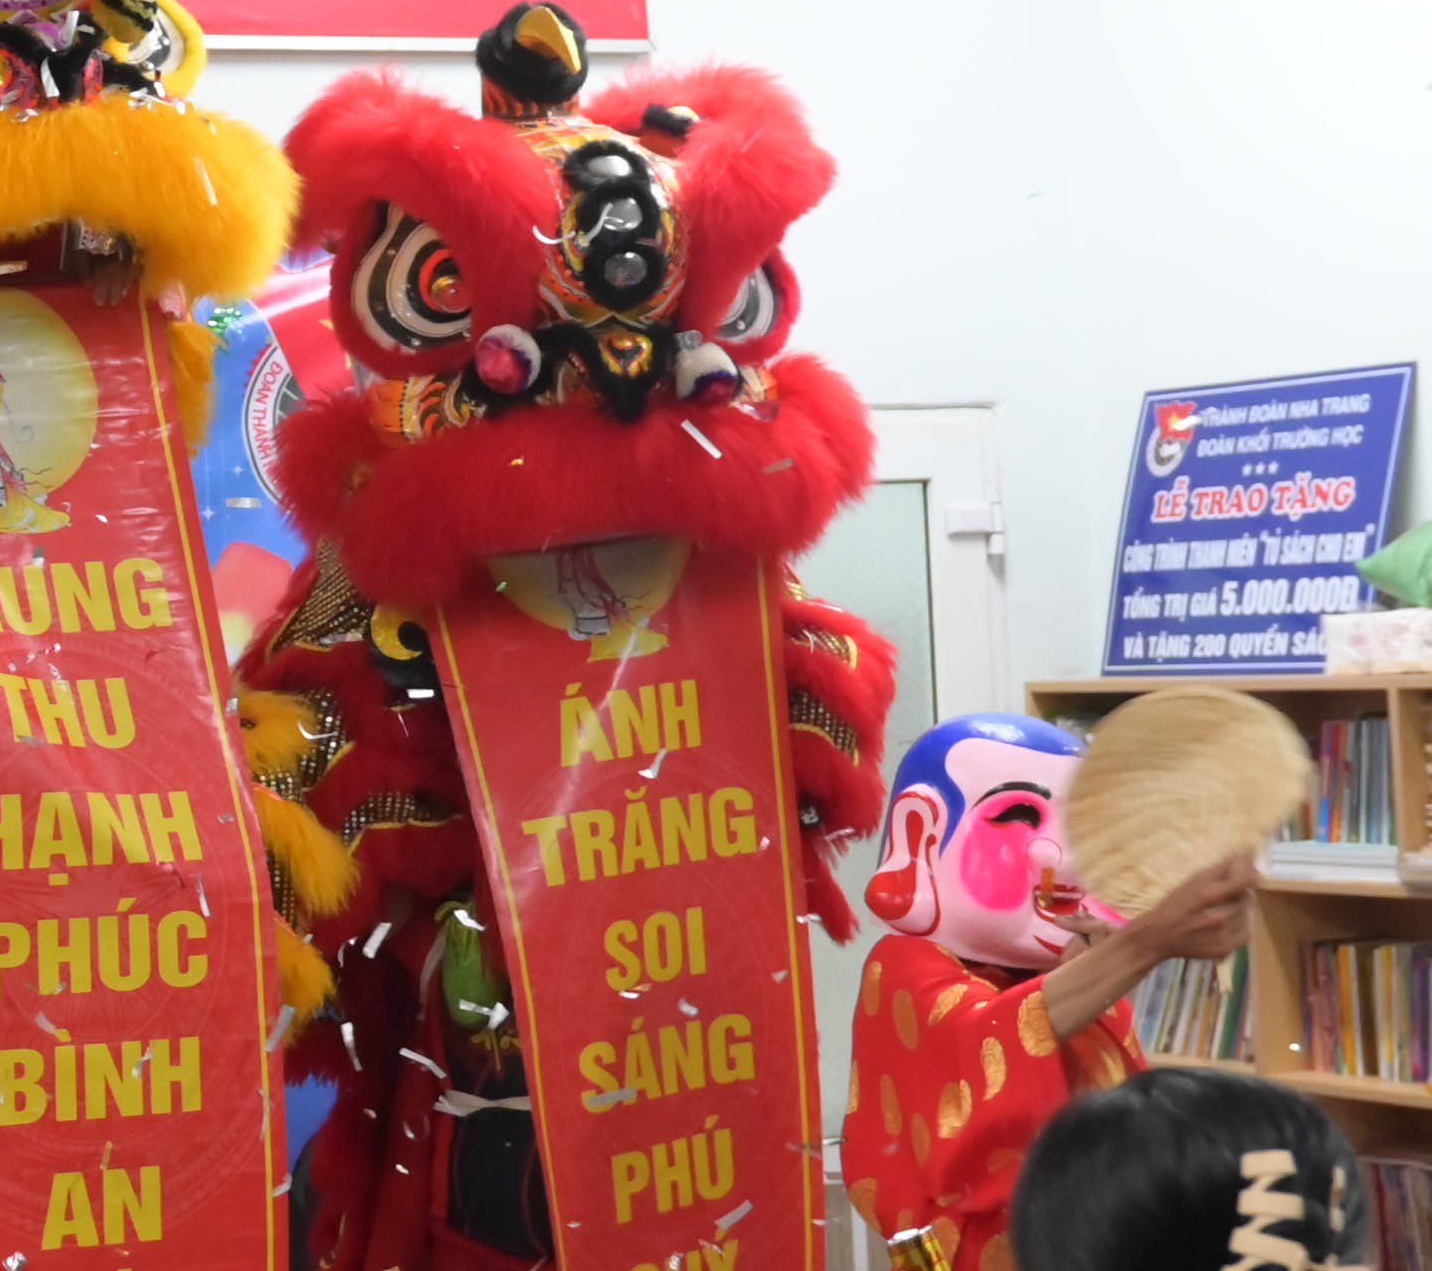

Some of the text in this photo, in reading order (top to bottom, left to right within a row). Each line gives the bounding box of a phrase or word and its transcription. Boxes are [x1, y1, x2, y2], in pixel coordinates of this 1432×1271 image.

[1197, 424, 1364, 457] ĐOÀN KHỐI TRƯỜNG HỌC
[1249, 400, 1286, 423] ĐOÀN
[1289, 400, 1318, 418] NHA
[1321, 394, 1371, 415] TRANG
[1151, 471, 1355, 522] LỄ TRAO TẶNG
[1123, 587, 1161, 619] TỔNG
[1164, 593, 1188, 622] TRỊ
[1190, 587, 1217, 616] GIÁ
[1123, 623, 1327, 662] VÀ TẶNG 200 QUYỂN SÁC
[560, 679, 701, 768] ÁNH
[522, 786, 758, 887] TRĂNG
[604, 906, 707, 991] SOI
[578, 1013, 755, 1114] SÁNG
[41, 1165, 162, 1250] AN
[611, 1115, 734, 1225] PHÚ
